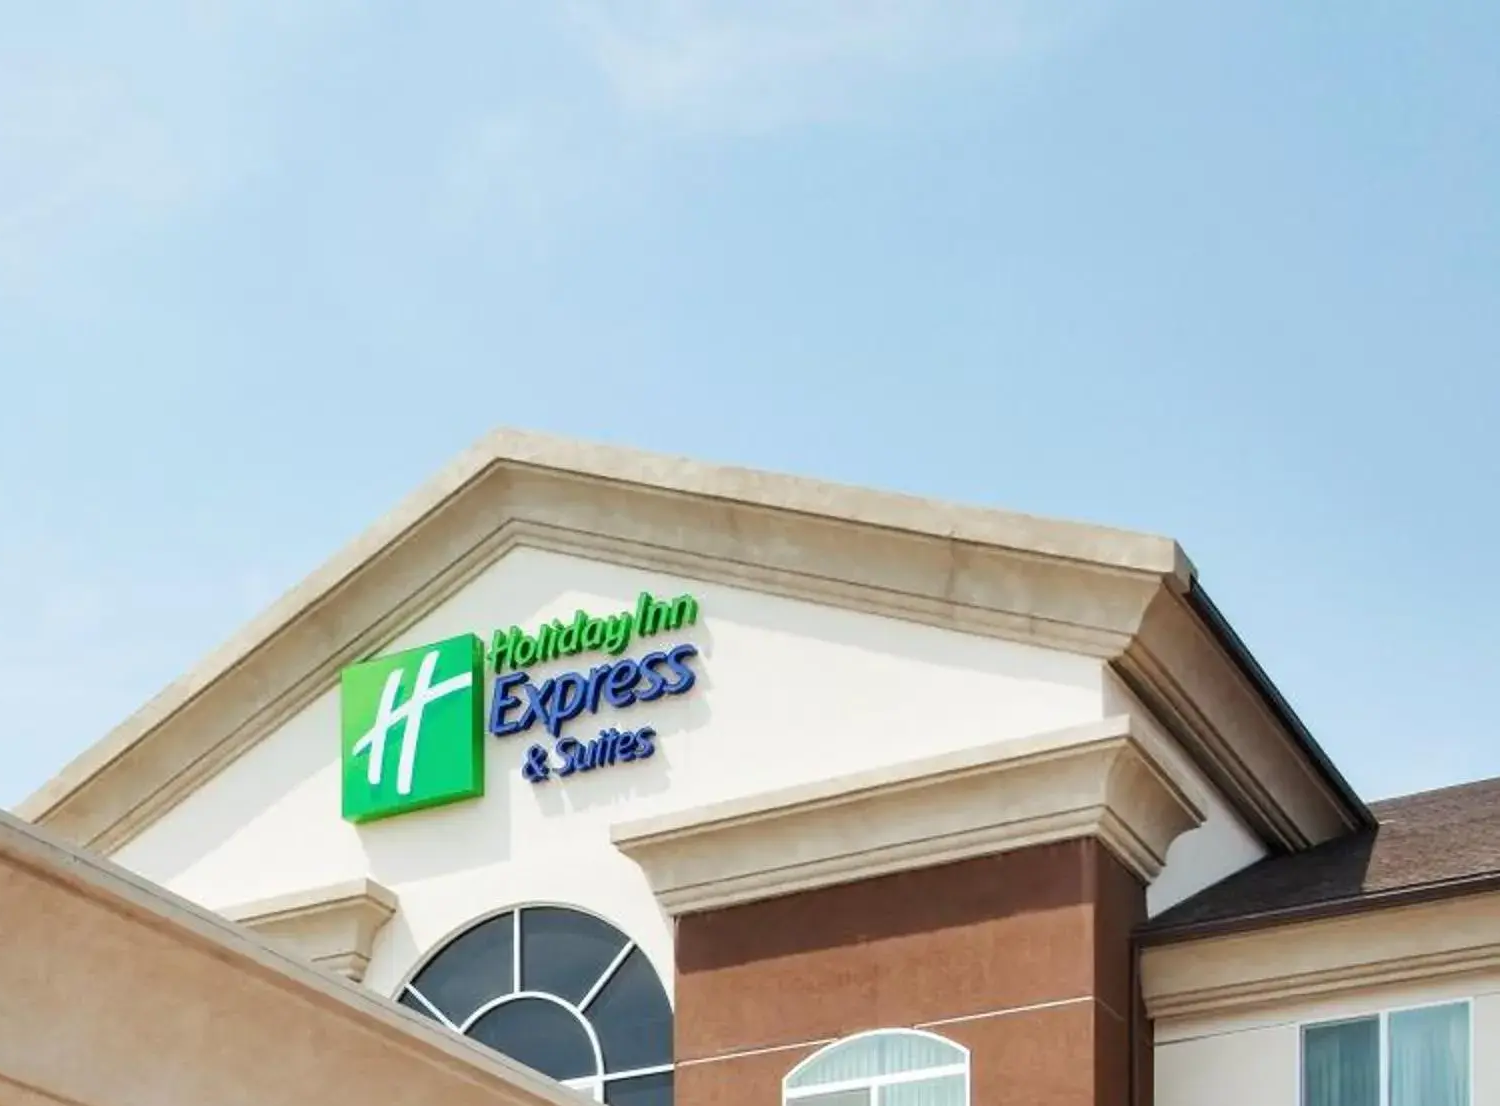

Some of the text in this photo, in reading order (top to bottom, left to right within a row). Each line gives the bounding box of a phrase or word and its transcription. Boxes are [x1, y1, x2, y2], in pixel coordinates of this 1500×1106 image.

[488, 591, 699, 674] Holiday Inn
[352, 649, 473, 795] H
[489, 643, 699, 738] Express
[522, 726, 657, 783] & Suites
